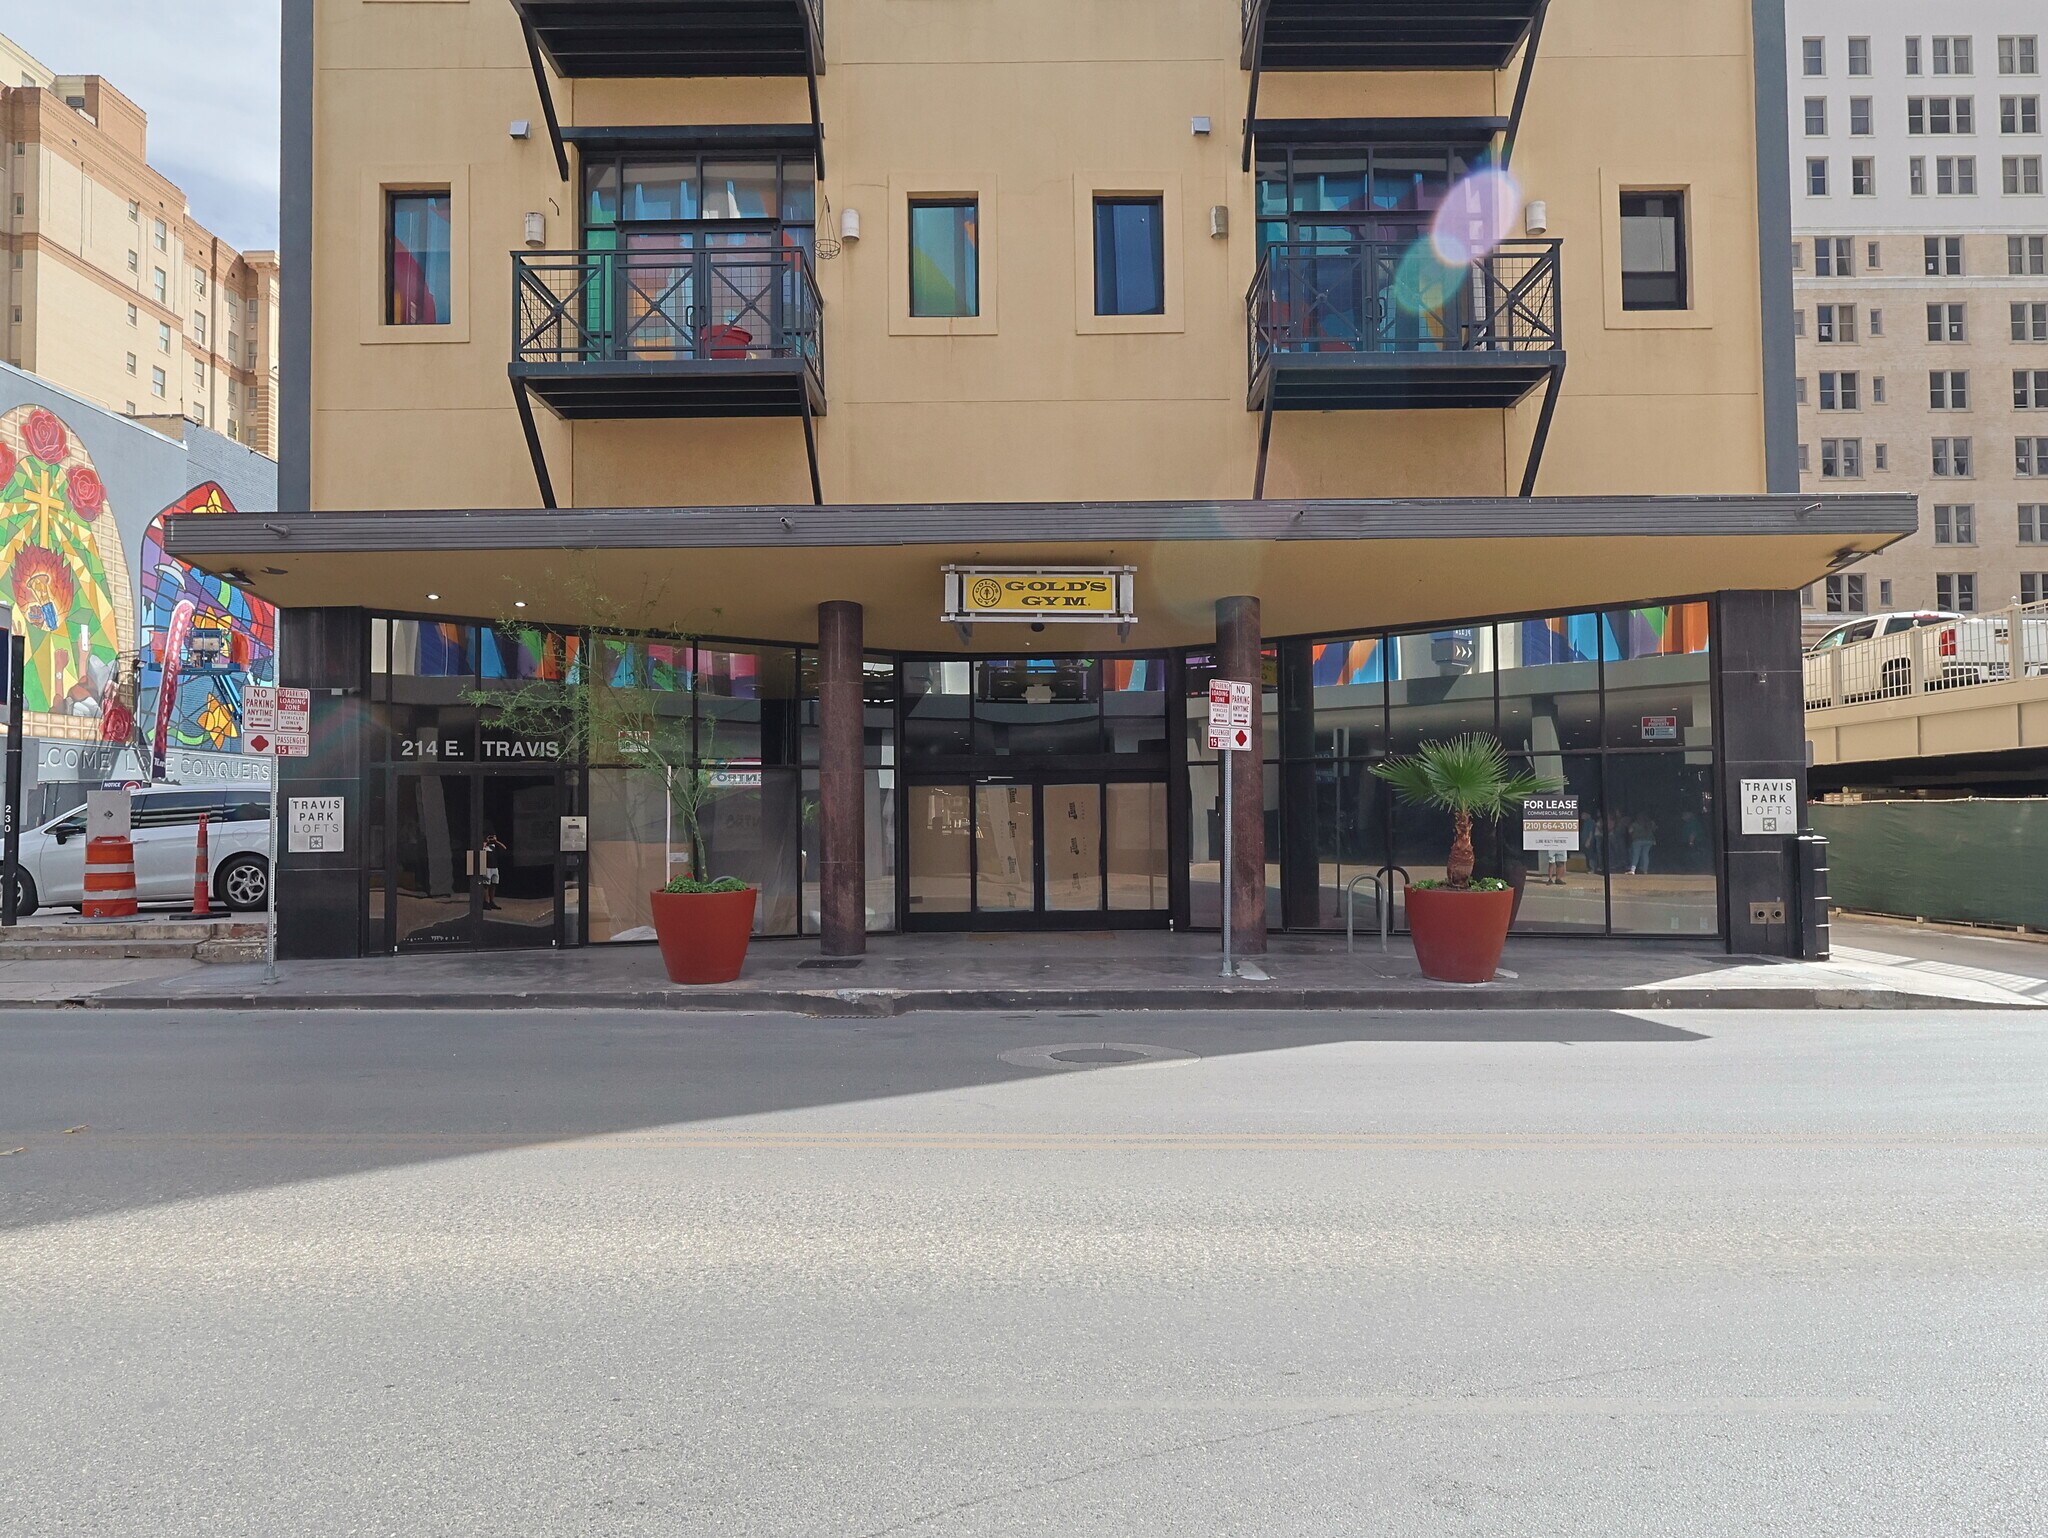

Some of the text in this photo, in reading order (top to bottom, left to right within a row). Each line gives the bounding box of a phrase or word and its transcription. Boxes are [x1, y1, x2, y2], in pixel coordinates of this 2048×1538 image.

[1004, 581, 1107, 592] GOLD'S
[253, 689, 267, 698] NO
[1236, 685, 1246, 694] NO
[286, 690, 307, 699] PARKING
[246, 698, 274, 709] PARKING
[280, 697, 306, 705] LOADING
[1232, 695, 1250, 704] PARKING
[1644, 727, 1655, 736] NO
[277, 736, 305, 744] PASSENGER
[1211, 738, 1217, 747] 15
[277, 746, 287, 754] 15
[401, 740, 560, 757] 214 E. TRAVIS
[180, 756, 270, 781] CONQUERS
[1745, 782, 1792, 791] TRAVIS
[1752, 794, 1786, 803] PARK
[293, 800, 340, 809] TRAVIS
[1524, 800, 1578, 809] FOR LEASE
[1746, 806, 1792, 815] LOFTS
[299, 812, 334, 821] PARK
[293, 823, 339, 833] LOFTS
[1524, 822, 1578, 831] (210) 664-3105
